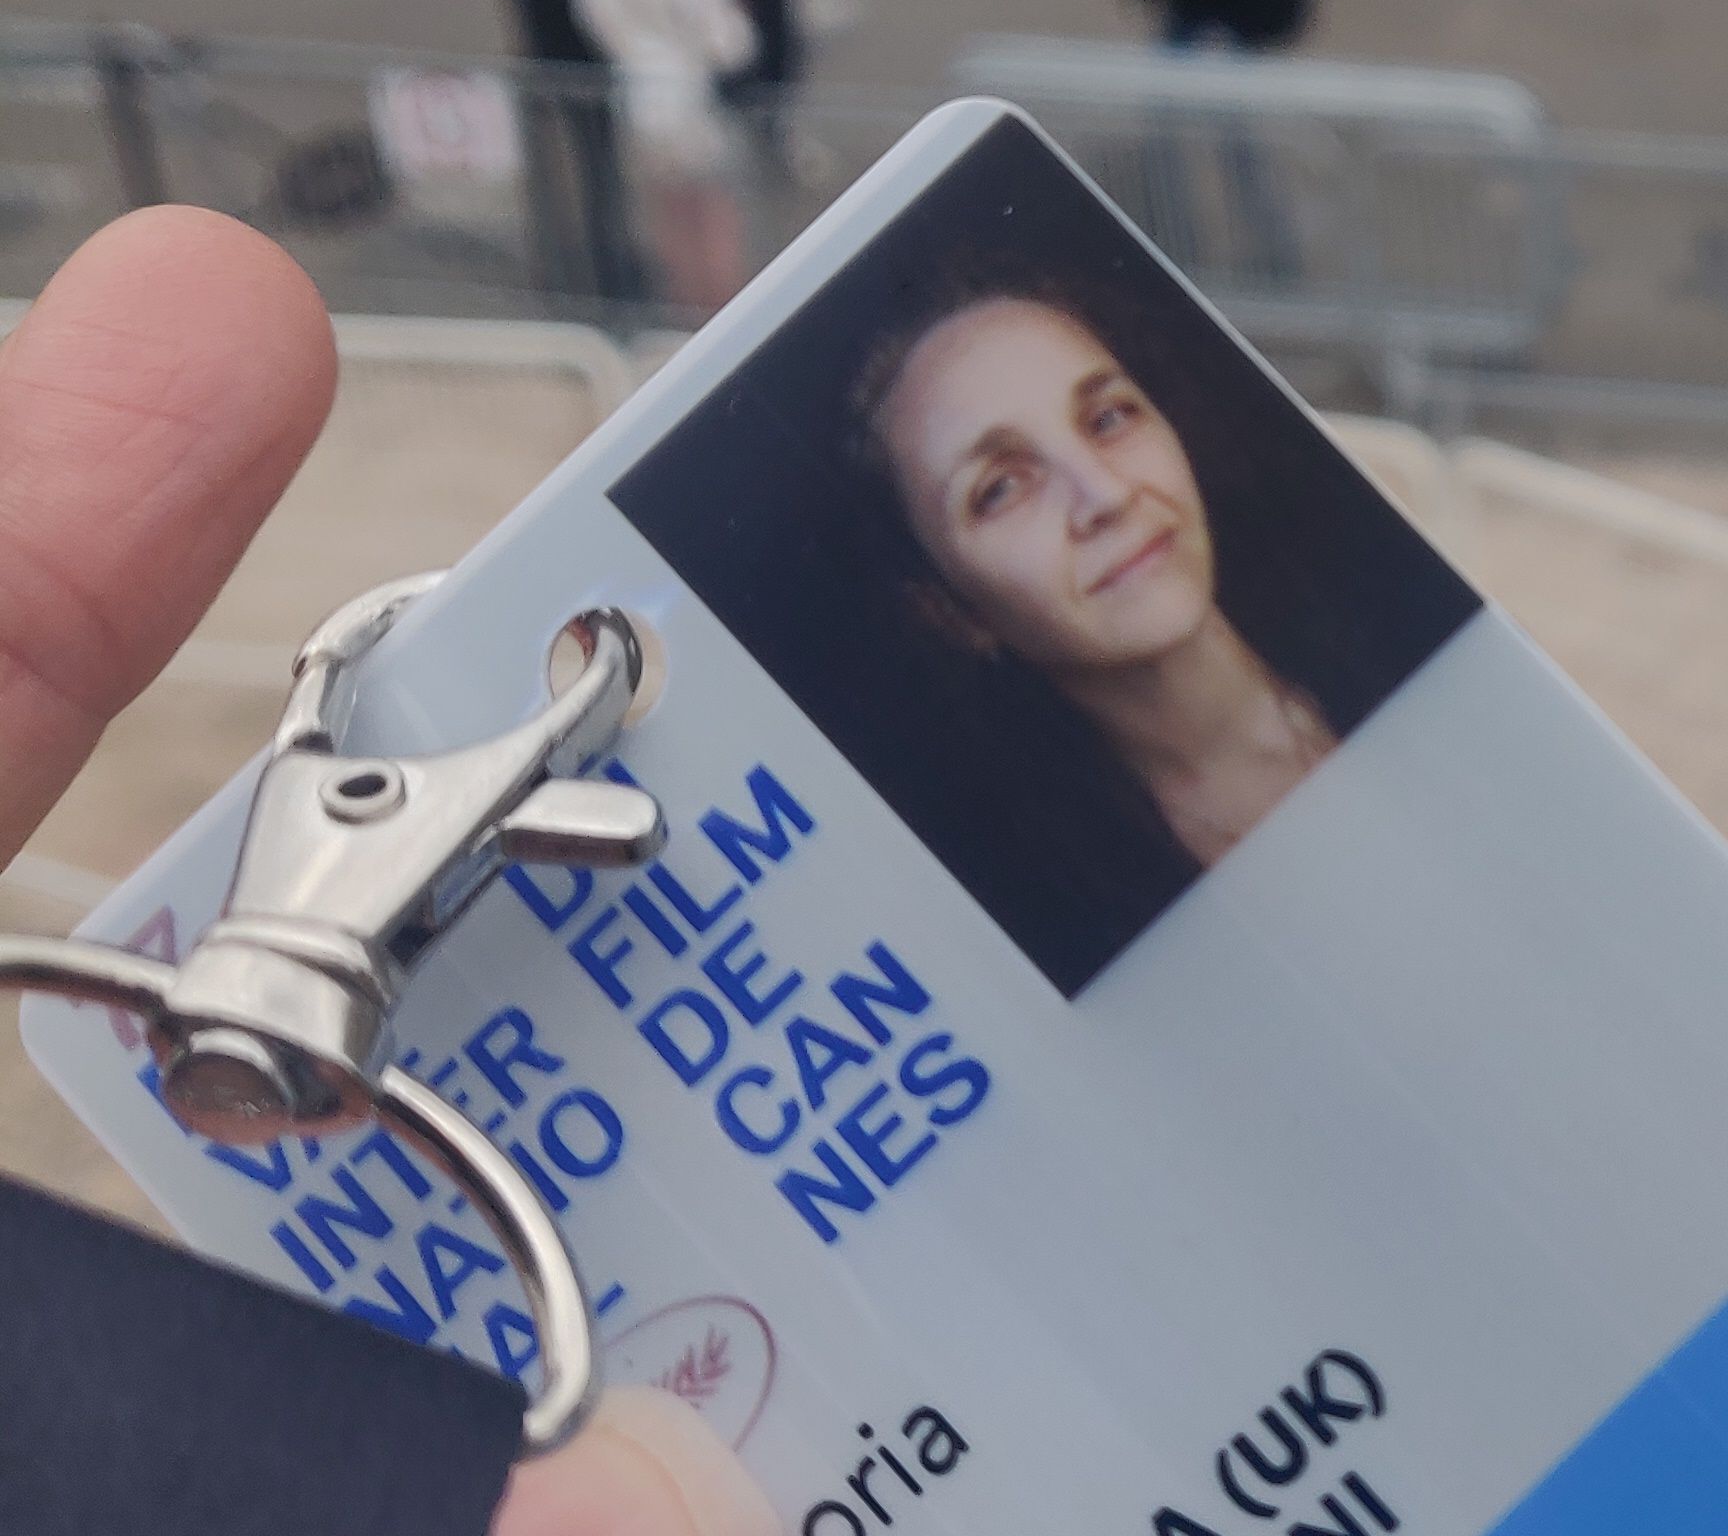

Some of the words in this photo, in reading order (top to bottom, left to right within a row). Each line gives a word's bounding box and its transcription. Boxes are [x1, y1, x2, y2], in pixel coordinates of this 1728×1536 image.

[566, 762, 817, 1011] FILM
[637, 920, 805, 1087] DE
[715, 941, 933, 1154] CAN
[343, 1088, 625, 1345] NAIO
[775, 1032, 990, 1245] NES
[1214, 1347, 1386, 1519] (UK)
